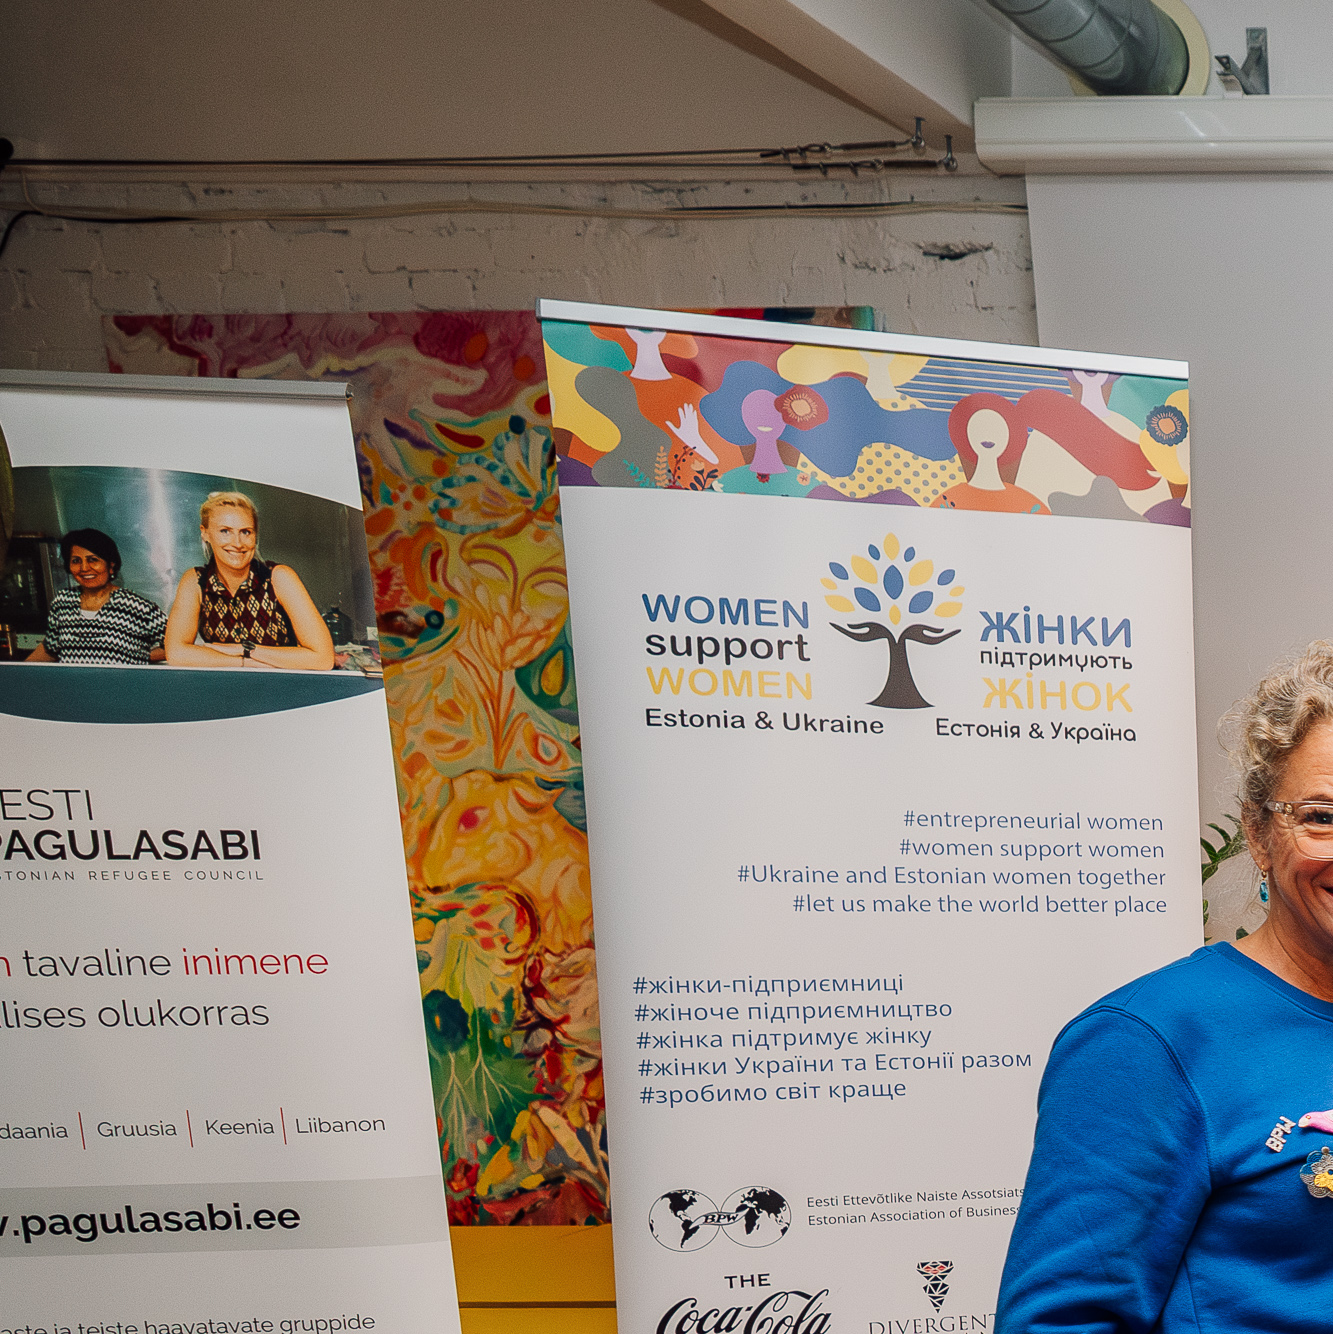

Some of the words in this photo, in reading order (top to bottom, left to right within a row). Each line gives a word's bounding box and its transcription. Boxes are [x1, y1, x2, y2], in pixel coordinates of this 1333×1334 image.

[641, 593, 809, 629] WOMEN
[645, 633, 811, 666] support
[980, 646, 1133, 673] підтримують
[646, 666, 813, 701] WOMEN
[645, 707, 746, 729] Estonia
[754, 710, 774, 730] &
[782, 711, 884, 734] Ukraine
[935, 716, 1021, 739] Естонія
[1028, 722, 1045, 739] &
[1050, 721, 1137, 745] Україна
[0, 789, 94, 820] ESTI
[903, 810, 1081, 832] #entrepreneurial
[1086, 816, 1164, 830] women
[0, 829, 261, 861] AGULASABI
[899, 838, 994, 857] #women
[1000, 842, 1082, 861] support
[1088, 844, 1165, 858] women
[0, 870, 76, 881] TONIAN
[88, 870, 172, 881] REFUGEE
[184, 870, 264, 881] COUNCIL
[737, 864, 840, 883] #Ukraine
[846, 866, 888, 884] and
[895, 866, 986, 885] Estonian
[992, 871, 1071, 885] women
[1077, 868, 1167, 889] together
[792, 893, 835, 913] #let
[841, 898, 866, 913] us
[872, 894, 932, 913] make
[937, 894, 974, 913] the
[979, 894, 1039, 914] world
[1046, 894, 1109, 914] better
[1114, 895, 1168, 917] place
[22, 949, 171, 977] tavaline
[182, 948, 329, 975] inimene
[632, 974, 904, 998] #жінки-підприємниці
[0, 999, 86, 1028] lises
[98, 998, 270, 1027] olukorras
[634, 1003, 740, 1022] #жіноче
[748, 1001, 953, 1024] підприємництво
[636, 1030, 723, 1049] #жінка
[732, 1029, 859, 1051] підтримує
[865, 1026, 932, 1048] жінку
[638, 1057, 727, 1077] #жінки
[734, 1055, 834, 1079] України
[841, 1057, 867, 1072] та
[875, 1051, 955, 1071] Естонії
[961, 1052, 1032, 1073] разом
[639, 1083, 768, 1109] #зробимо
[775, 1081, 821, 1100] світ
[828, 1083, 907, 1103] краще
[97, 1121, 177, 1138] Gruusia
[205, 1118, 274, 1136] Keenia
[295, 1116, 386, 1134] Liibanon
[806, 1196, 839, 1208] Eesti
[843, 1192, 913, 1206] Ettevõtlike
[916, 1189, 958, 1203] Naiste
[703, 1214, 739, 1223] BPW
[808, 1212, 867, 1226] Estonian
[870, 1208, 946, 1223] Association
[949, 1207, 963, 1218] of
[724, 1273, 770, 1289] THE
